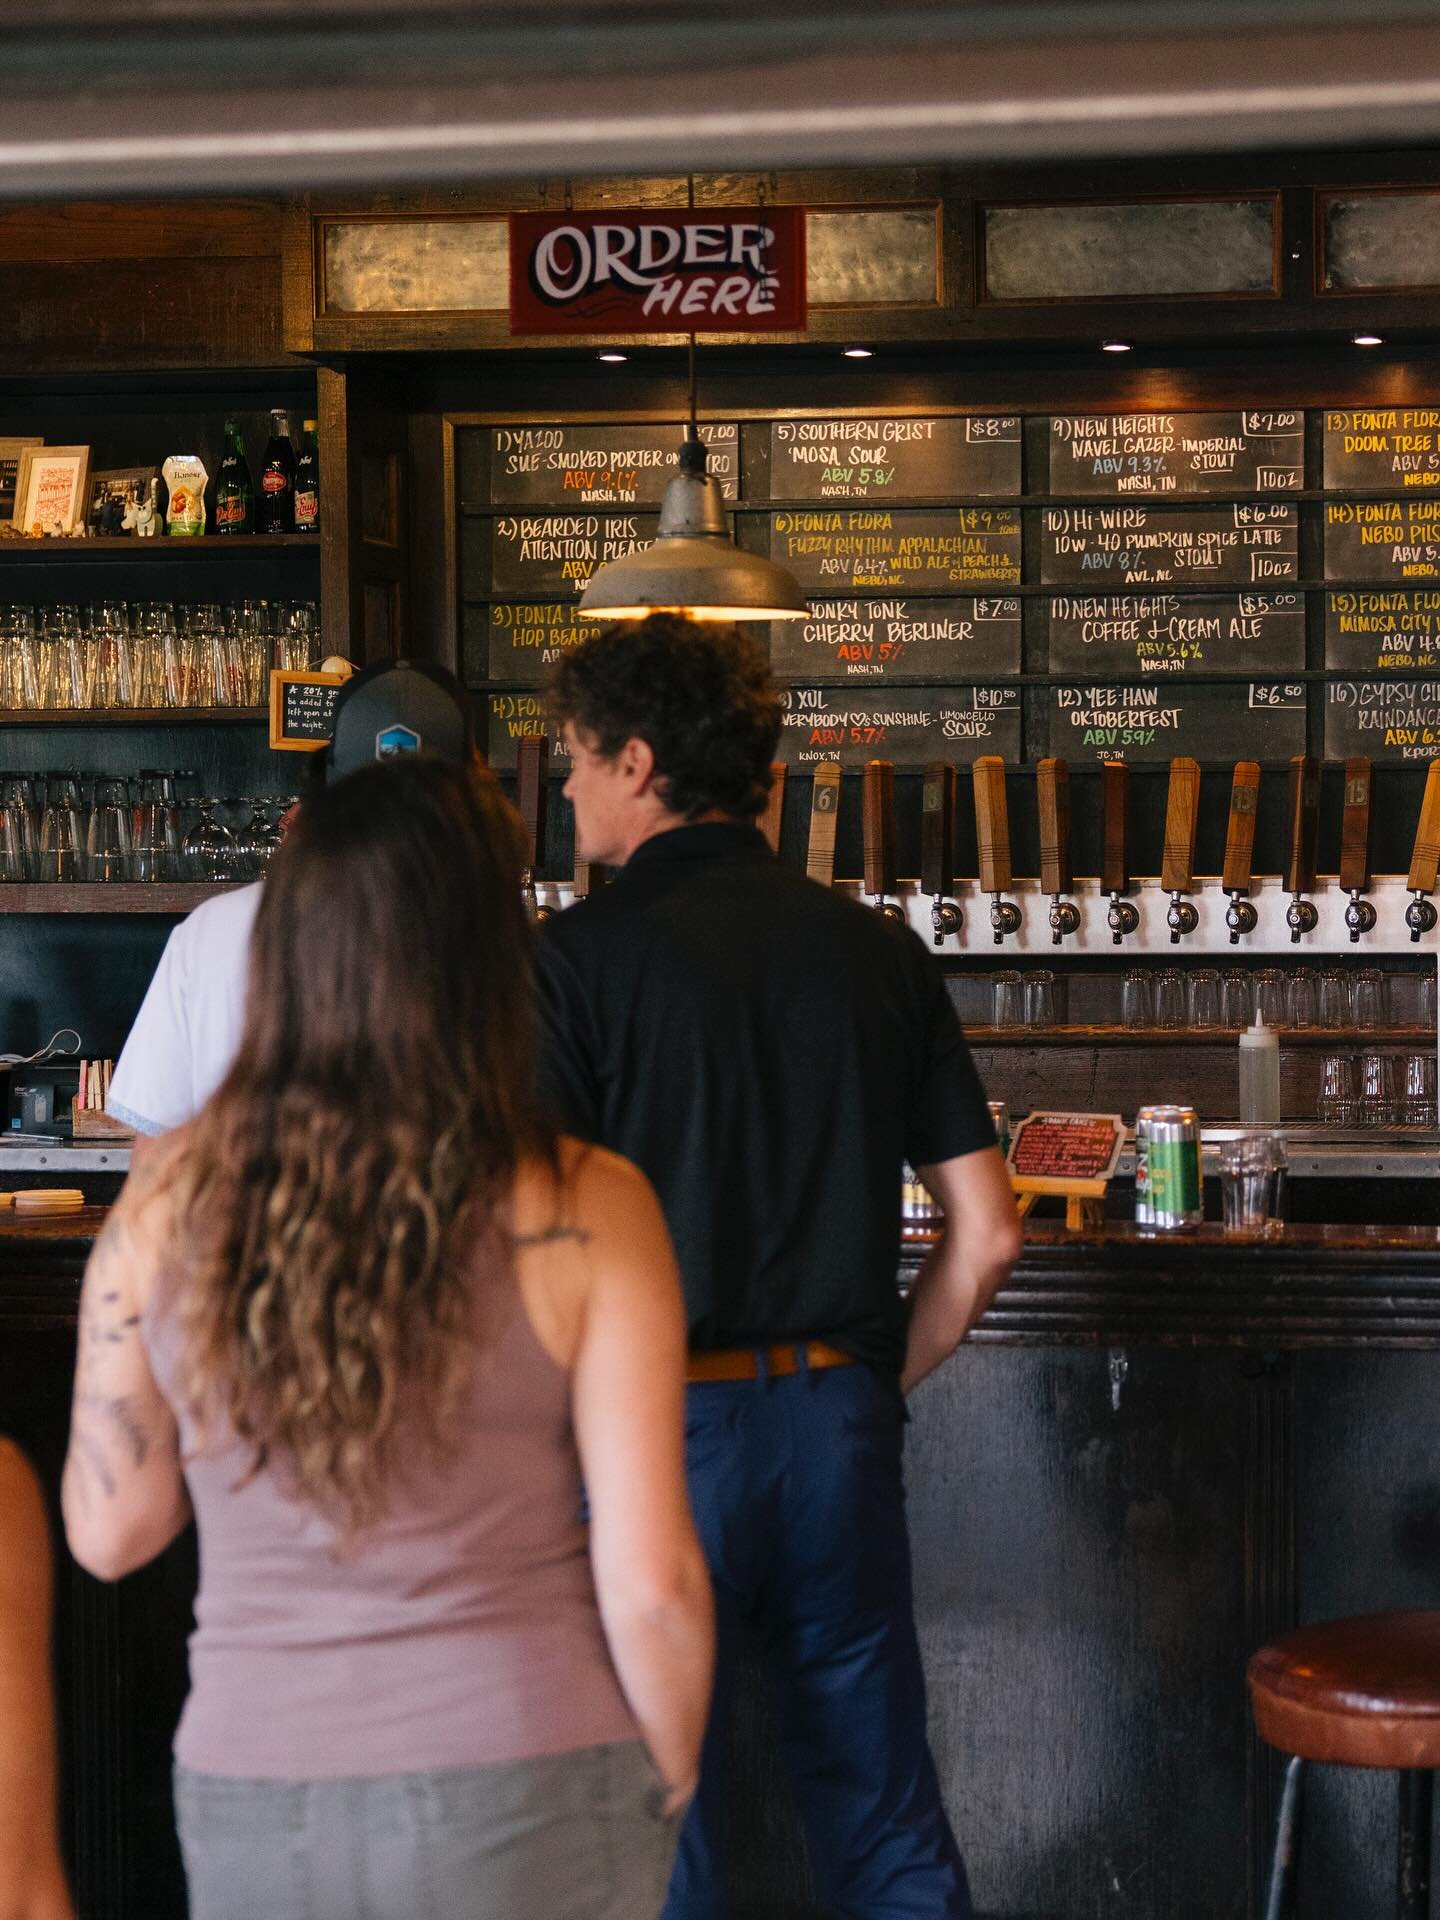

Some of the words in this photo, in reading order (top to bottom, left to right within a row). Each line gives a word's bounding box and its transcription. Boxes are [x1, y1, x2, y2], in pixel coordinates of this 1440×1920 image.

[535, 224, 776, 299] ORDER
[642, 276, 780, 316] HERE
[1074, 418, 1108, 438] NEW
[1112, 416, 1175, 436] HEIGHTS
[1352, 412, 1397, 431] FONTA
[1404, 412, 1440, 429] FLOR
[696, 426, 735, 442] 7.00
[799, 422, 879, 442] SOUTHERN
[883, 422, 936, 442] GRIST
[1072, 439, 1121, 459] NAVEL
[1392, 435, 1431, 453] TREE
[506, 451, 607, 474] SUE-SMOKED
[610, 450, 664, 472] PORTER
[848, 447, 889, 465] SOUR
[1191, 454, 1235, 470] STOUT
[1392, 456, 1422, 472] ABV
[1428, 454, 1440, 469] 5
[1093, 457, 1123, 475] ABV
[564, 472, 595, 489] ABV
[821, 468, 853, 485] ABV
[1356, 502, 1402, 521] FONTA
[520, 516, 598, 540] BEARDED
[606, 517, 639, 539] IRIS
[795, 514, 842, 533] FONTA
[849, 512, 893, 531] FLORA
[1126, 532, 1192, 549] PUMPKIN
[1198, 531, 1237, 549] SPICE
[1244, 530, 1282, 545] LATTE
[1361, 526, 1404, 545] NEBO
[520, 540, 597, 561] ATTENTION
[788, 538, 833, 557] FUZZY
[835, 537, 895, 556] RHYTHM
[899, 537, 987, 555] APPALACHIAN
[1392, 546, 1422, 563] ABV
[820, 559, 850, 575] ABV
[890, 556, 922, 570] WILD
[927, 556, 950, 569] ALE
[963, 554, 999, 568] PEACH
[1082, 552, 1114, 570] ABV
[1174, 549, 1225, 567] STOUT
[562, 562, 594, 579] ABV
[864, 602, 910, 621] TONK
[1072, 598, 1108, 619] NEW
[1112, 596, 1181, 617] HEIGHTS
[1360, 592, 1409, 613] FONTA
[516, 604, 563, 625] FONTA
[804, 622, 874, 643] CHERRY
[887, 619, 974, 643] BERLINER
[1082, 621, 1141, 643] COFFEE
[1168, 617, 1221, 641] CREAM
[1230, 618, 1264, 639] ALE
[1340, 616, 1397, 633] MIMOSA
[1401, 614, 1431, 634] CITY
[512, 628, 545, 648] HOP
[1382, 634, 1414, 652] ABV
[836, 644, 874, 661] ABV
[1136, 642, 1165, 657] ABV
[300, 698, 322, 707] added
[1360, 682, 1416, 707] GYPSY
[304, 711, 320, 719] open
[782, 712, 848, 727] VERYBODY
[873, 713, 931, 727] SUNSHINE
[940, 711, 995, 721] LIMONCELLO
[1071, 709, 1183, 729] OKTOBERFEST
[809, 728, 845, 745] ABV
[942, 722, 991, 737] SOUR
[1084, 729, 1117, 745] ABV
[1385, 730, 1418, 745] ABV
[818, 787, 831, 810] 6
